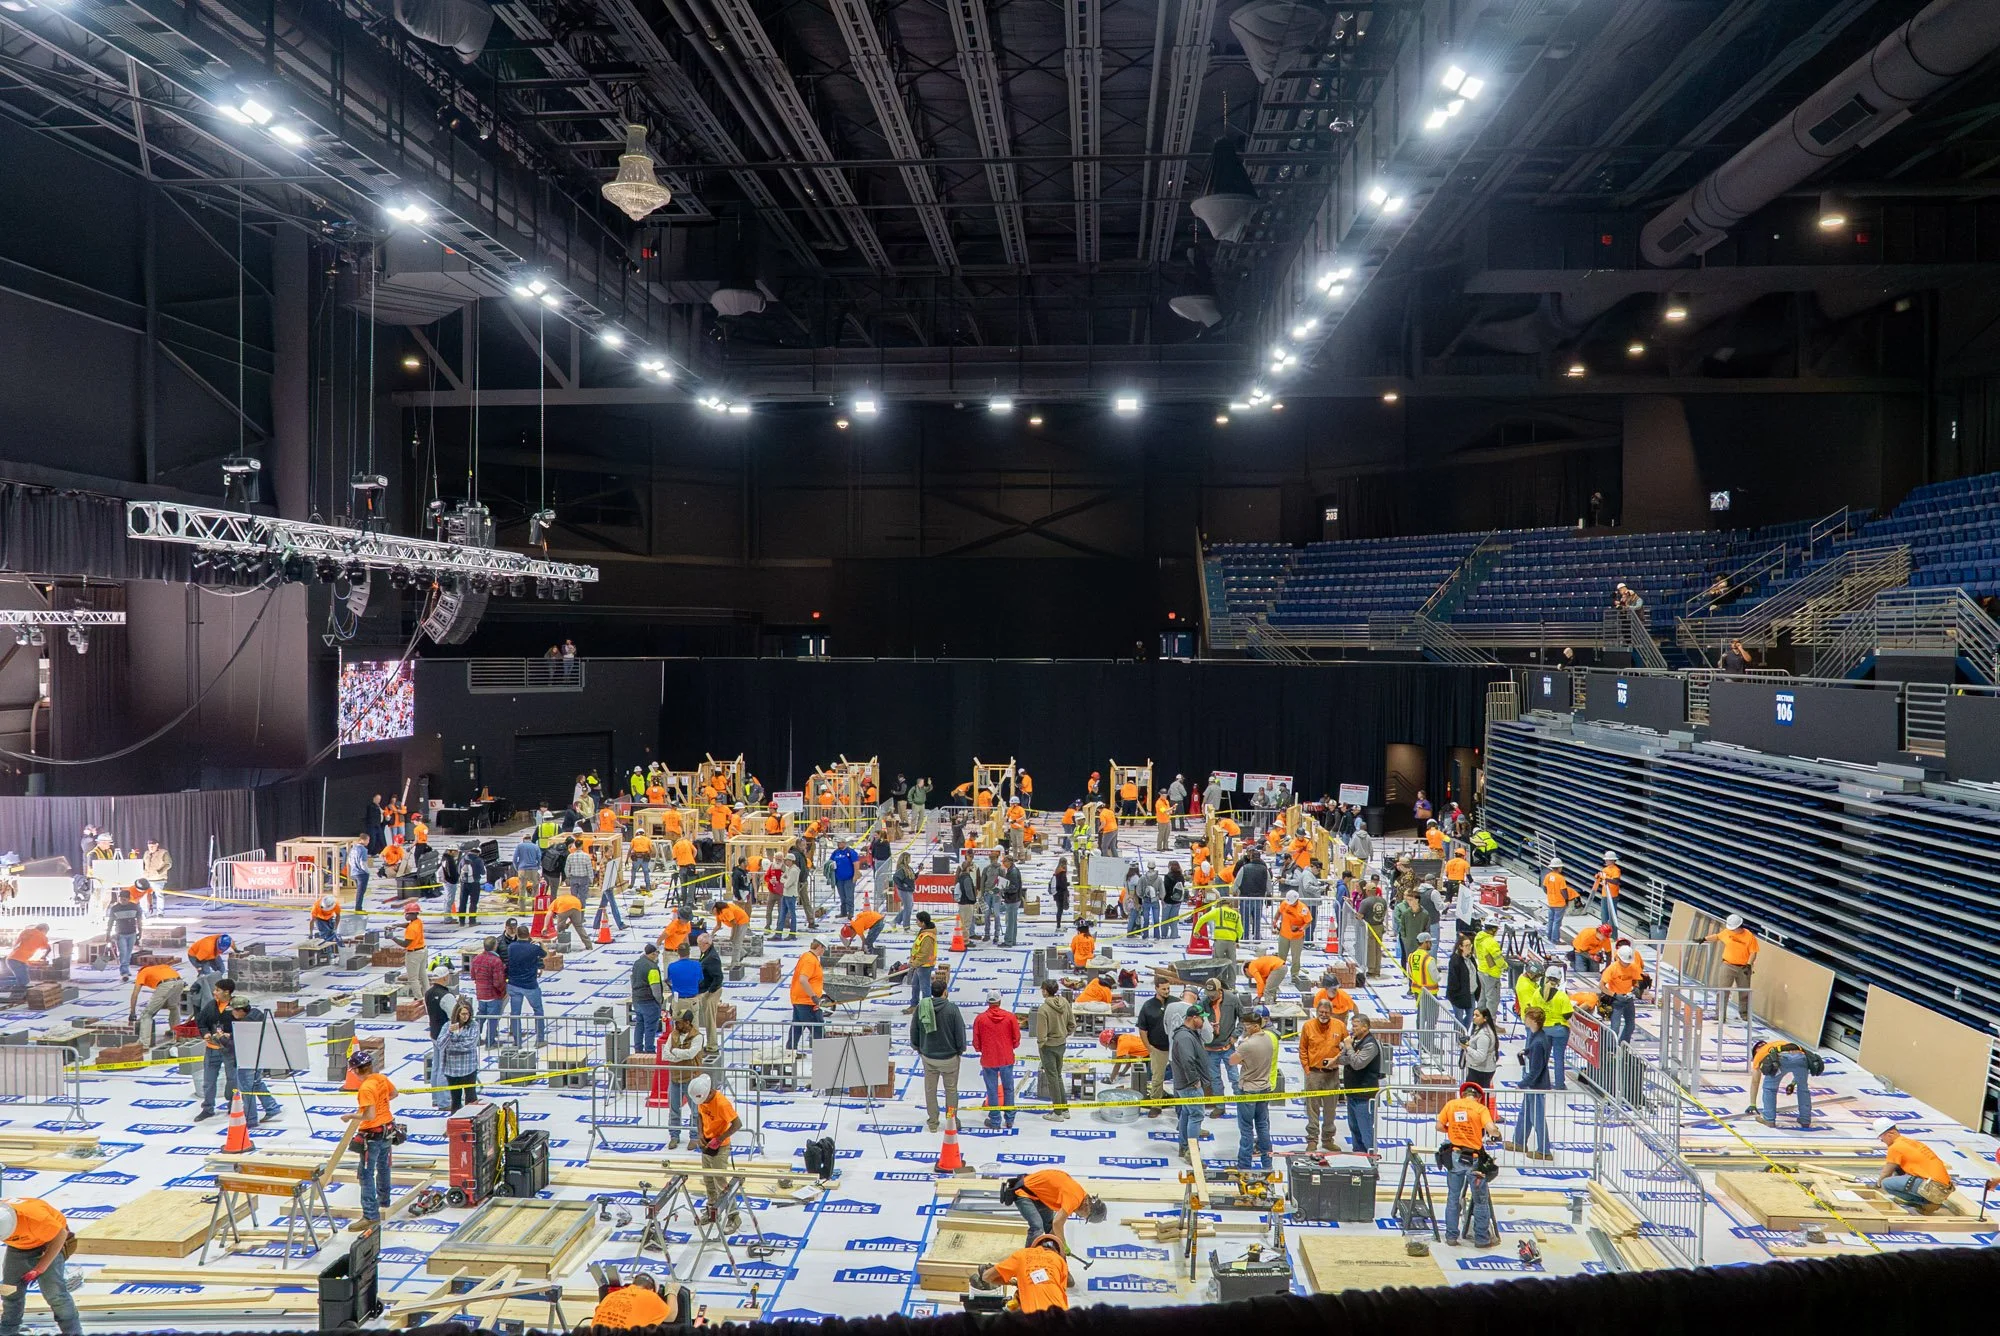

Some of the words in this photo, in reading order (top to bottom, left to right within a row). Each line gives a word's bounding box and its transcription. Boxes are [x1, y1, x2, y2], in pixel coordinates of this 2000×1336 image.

[1776, 703, 1793, 721] 106
[252, 866, 279, 874] TEAM
[247, 877, 284, 886] WORKS
[770, 1121, 821, 1130] LOWE'S
[864, 1124, 916, 1132] LOWE'S
[1057, 1130, 1110, 1138] LOWE'S
[883, 1172, 939, 1181] LOWE'S
[853, 1241, 919, 1252] LOWE'S
[843, 1272, 912, 1283] LOWE'S
